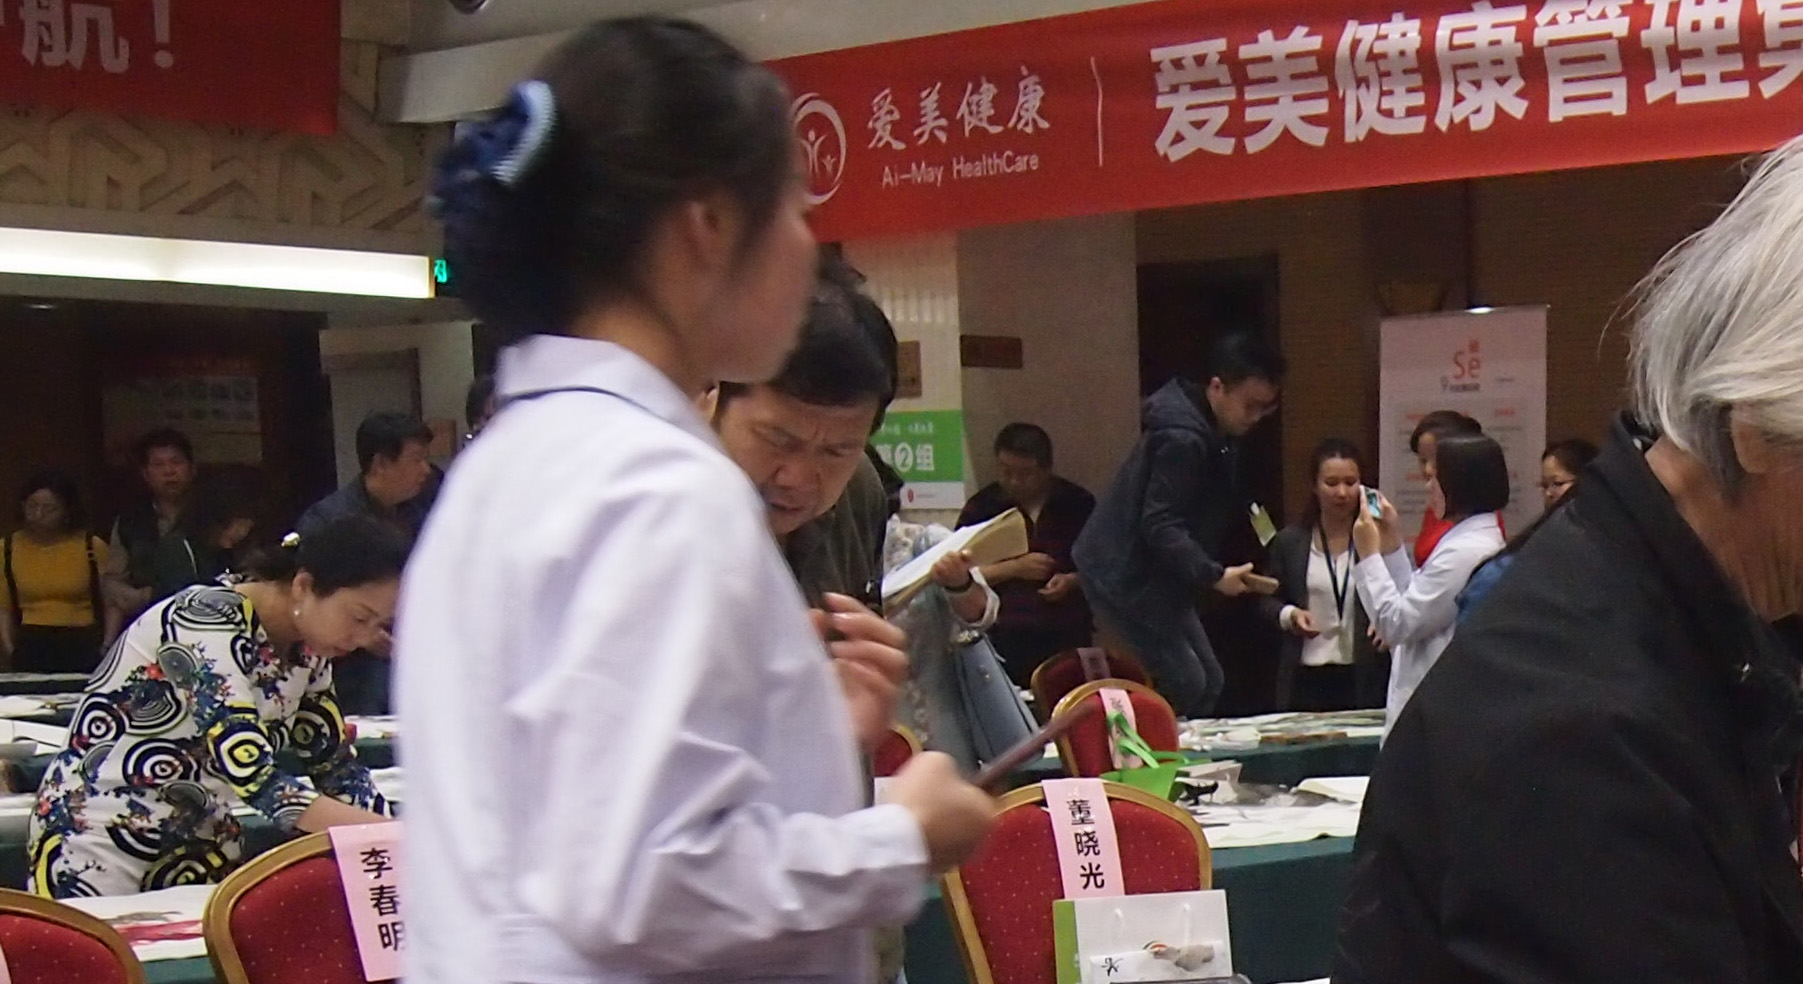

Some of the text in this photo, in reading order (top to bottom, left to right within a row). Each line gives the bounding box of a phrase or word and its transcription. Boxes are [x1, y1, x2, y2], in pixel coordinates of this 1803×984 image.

[867, 65, 1050, 150] 爱美健康
[953, 151, 1039, 180] HealthCare
[360, 847, 405, 951] 李春明
